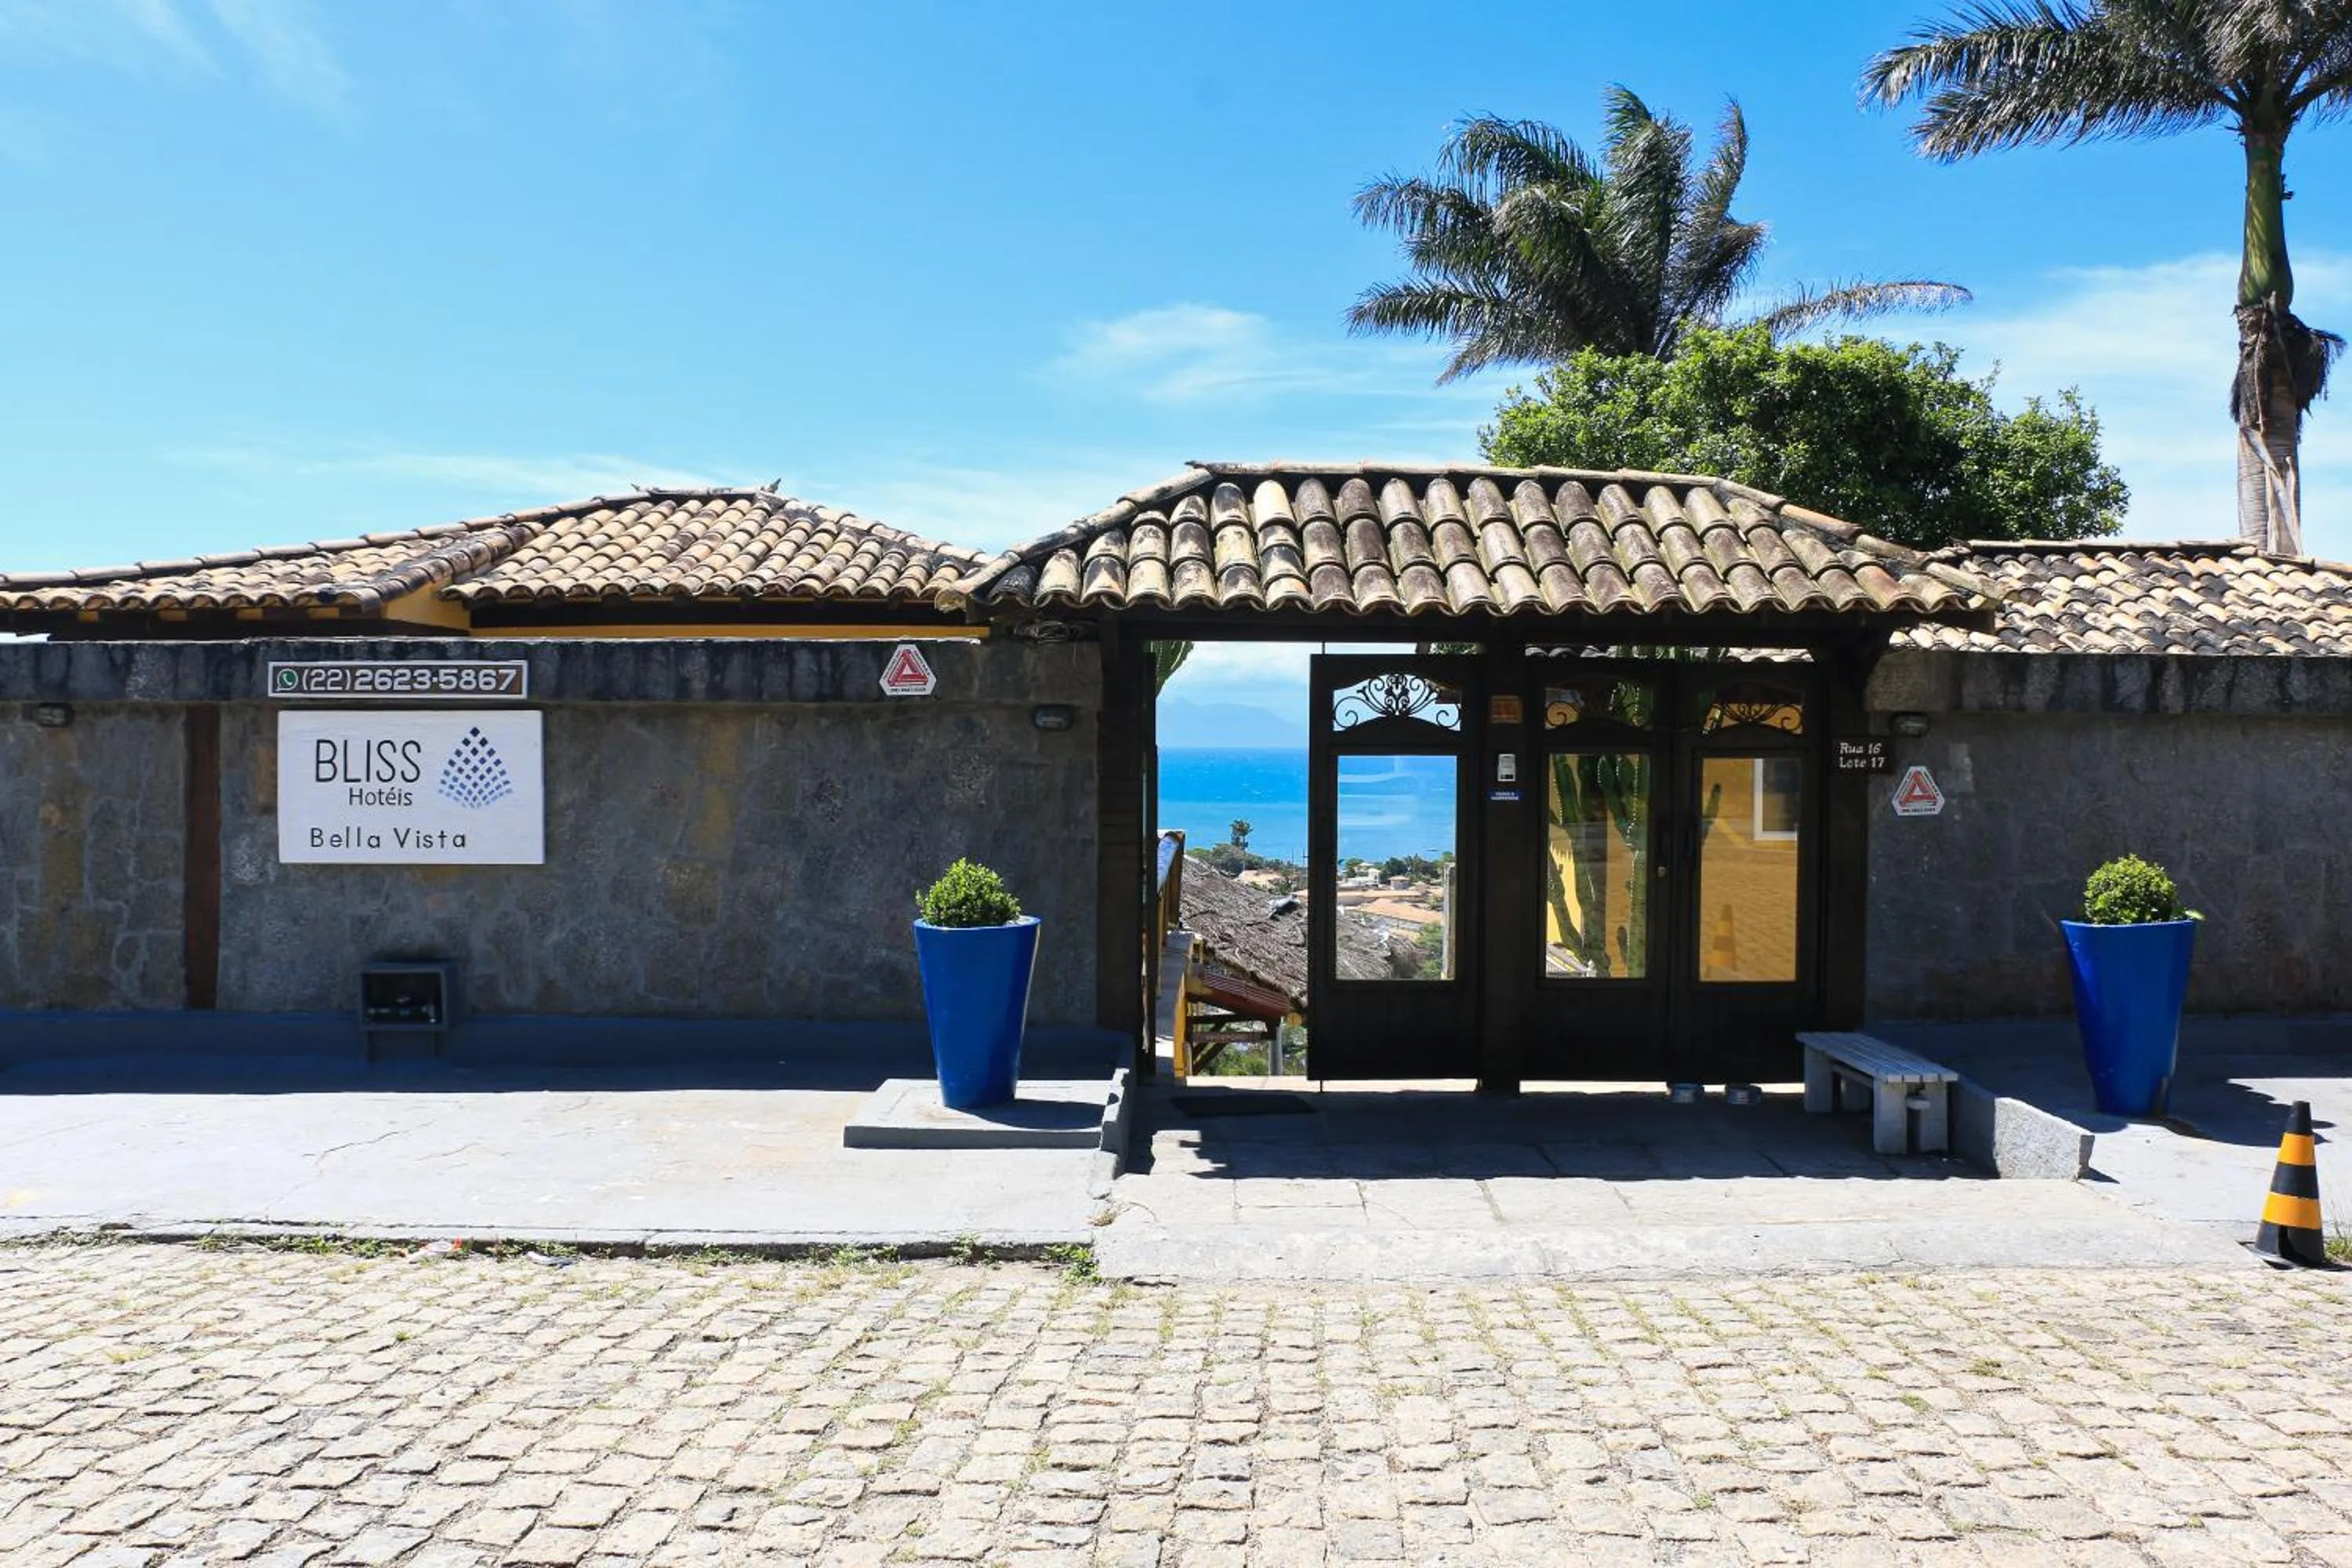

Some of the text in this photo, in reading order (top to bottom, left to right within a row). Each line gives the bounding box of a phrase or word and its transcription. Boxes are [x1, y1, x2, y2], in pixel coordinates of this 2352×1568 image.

[1839, 743, 1882, 754] Rua 16
[315, 739, 421, 783] BLISS
[1839, 757, 1886, 768] Lote 17
[349, 786, 413, 806] Hotéis
[310, 826, 466, 848] Bella Vista
